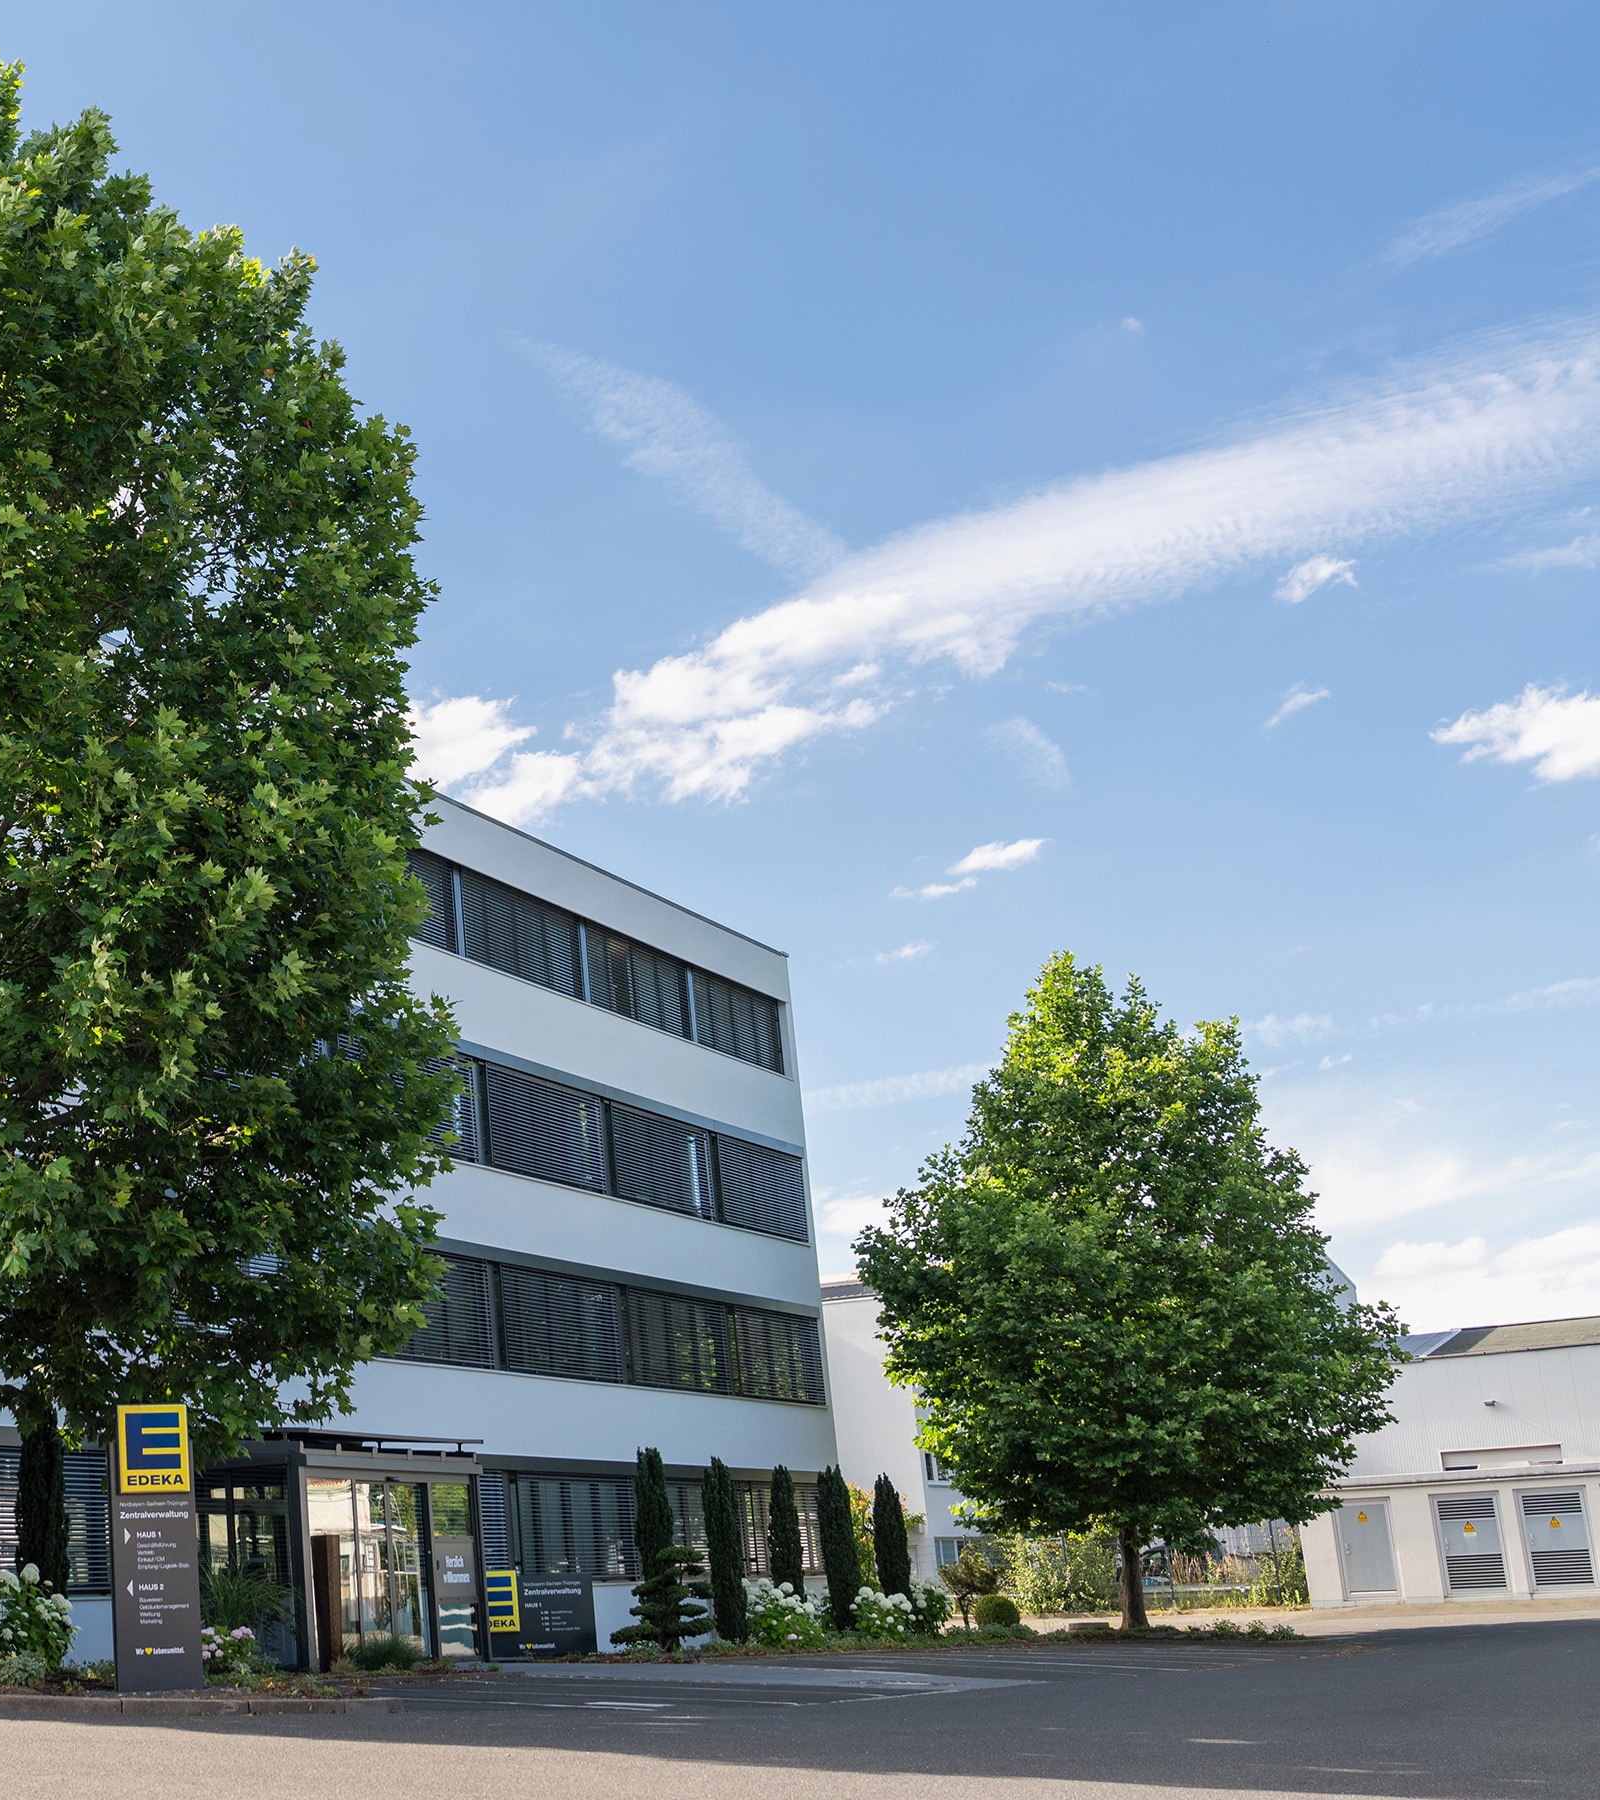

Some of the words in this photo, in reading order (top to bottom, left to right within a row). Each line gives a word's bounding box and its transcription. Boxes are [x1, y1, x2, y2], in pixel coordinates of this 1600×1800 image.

[125, 1412, 181, 1470] E
[127, 1474, 184, 1486] EDEKA
[119, 1510, 189, 1519] Zentralverwaltung
[136, 1531, 157, 1539] HAUS
[524, 1587, 582, 1596] Zentralverwaltung
[489, 1619, 516, 1628] DEKA
